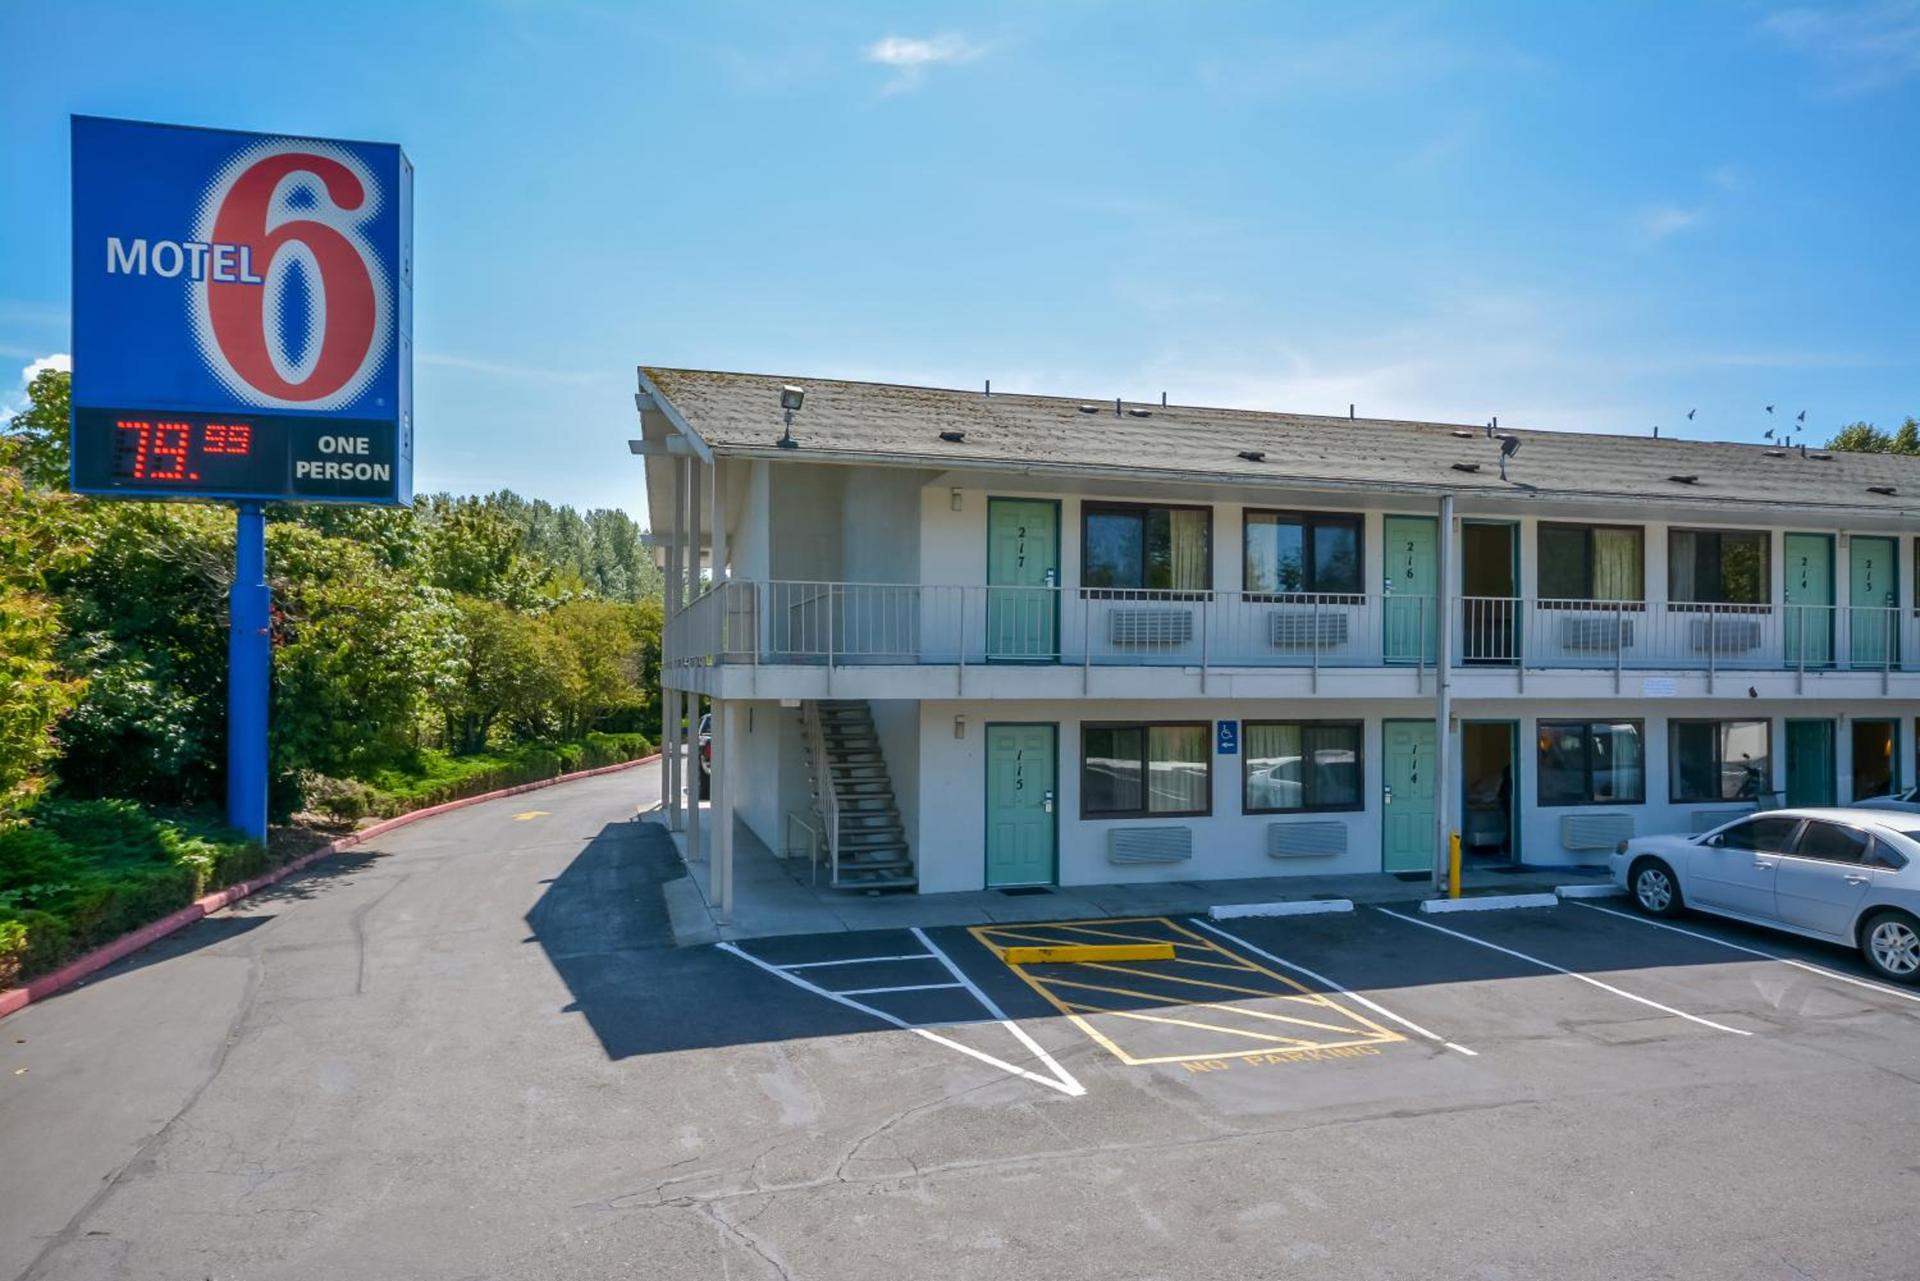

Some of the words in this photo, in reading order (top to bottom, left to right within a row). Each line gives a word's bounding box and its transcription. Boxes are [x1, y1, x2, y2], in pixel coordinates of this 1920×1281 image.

[106, 237, 262, 284] MOTEL
[206, 152, 376, 402] 6
[318, 435, 370, 455] ONE
[296, 461, 390, 481] PERSON
[1018, 526, 1026, 568] 217
[1015, 749, 1023, 790] 115
[1181, 1059, 1229, 1073] NO
[1242, 1044, 1381, 1067] PARKING
